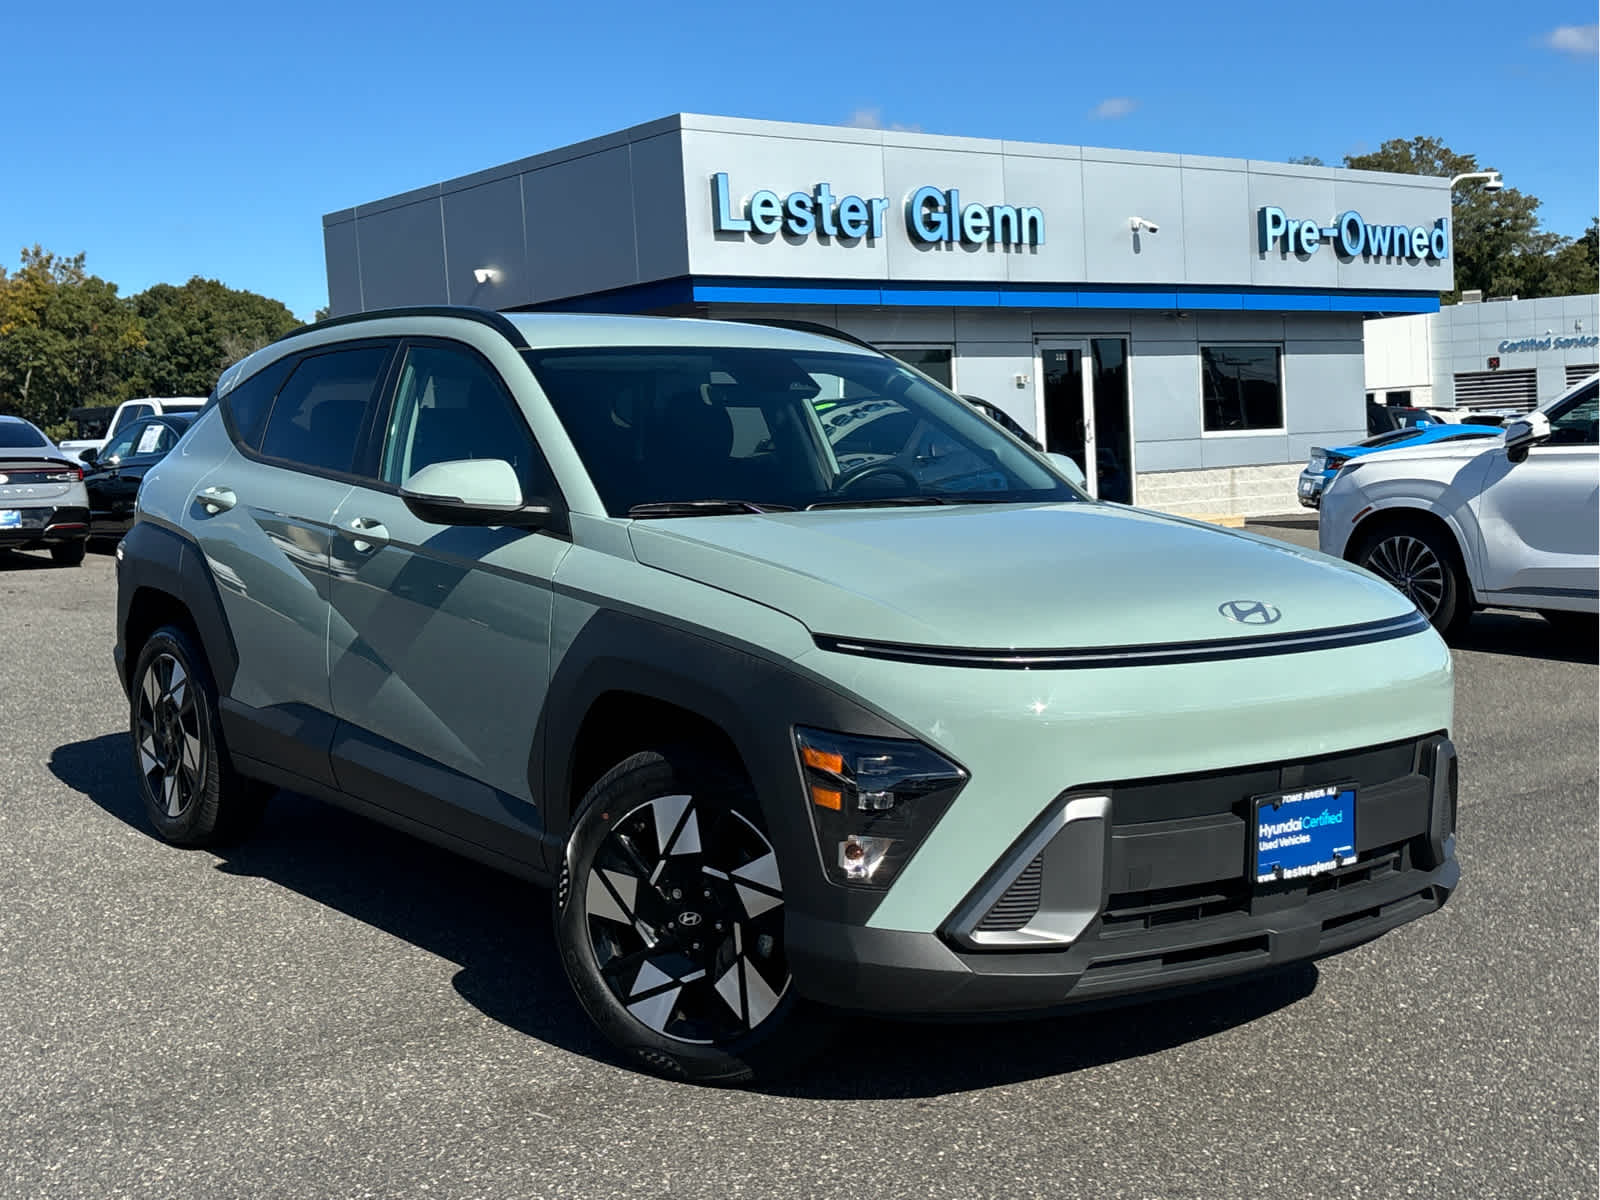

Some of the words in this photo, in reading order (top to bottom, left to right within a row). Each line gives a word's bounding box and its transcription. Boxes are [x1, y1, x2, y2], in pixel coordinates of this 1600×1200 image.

[710, 172, 888, 240] Lester
[905, 185, 1046, 246] Glenn
[1258, 205, 1449, 260] Pre-Owned
[1498, 337, 1552, 353] Certified
[1553, 335, 1599, 350] Service
[1259, 839, 1278, 851] Used
[1279, 834, 1311, 847] Vehicles
